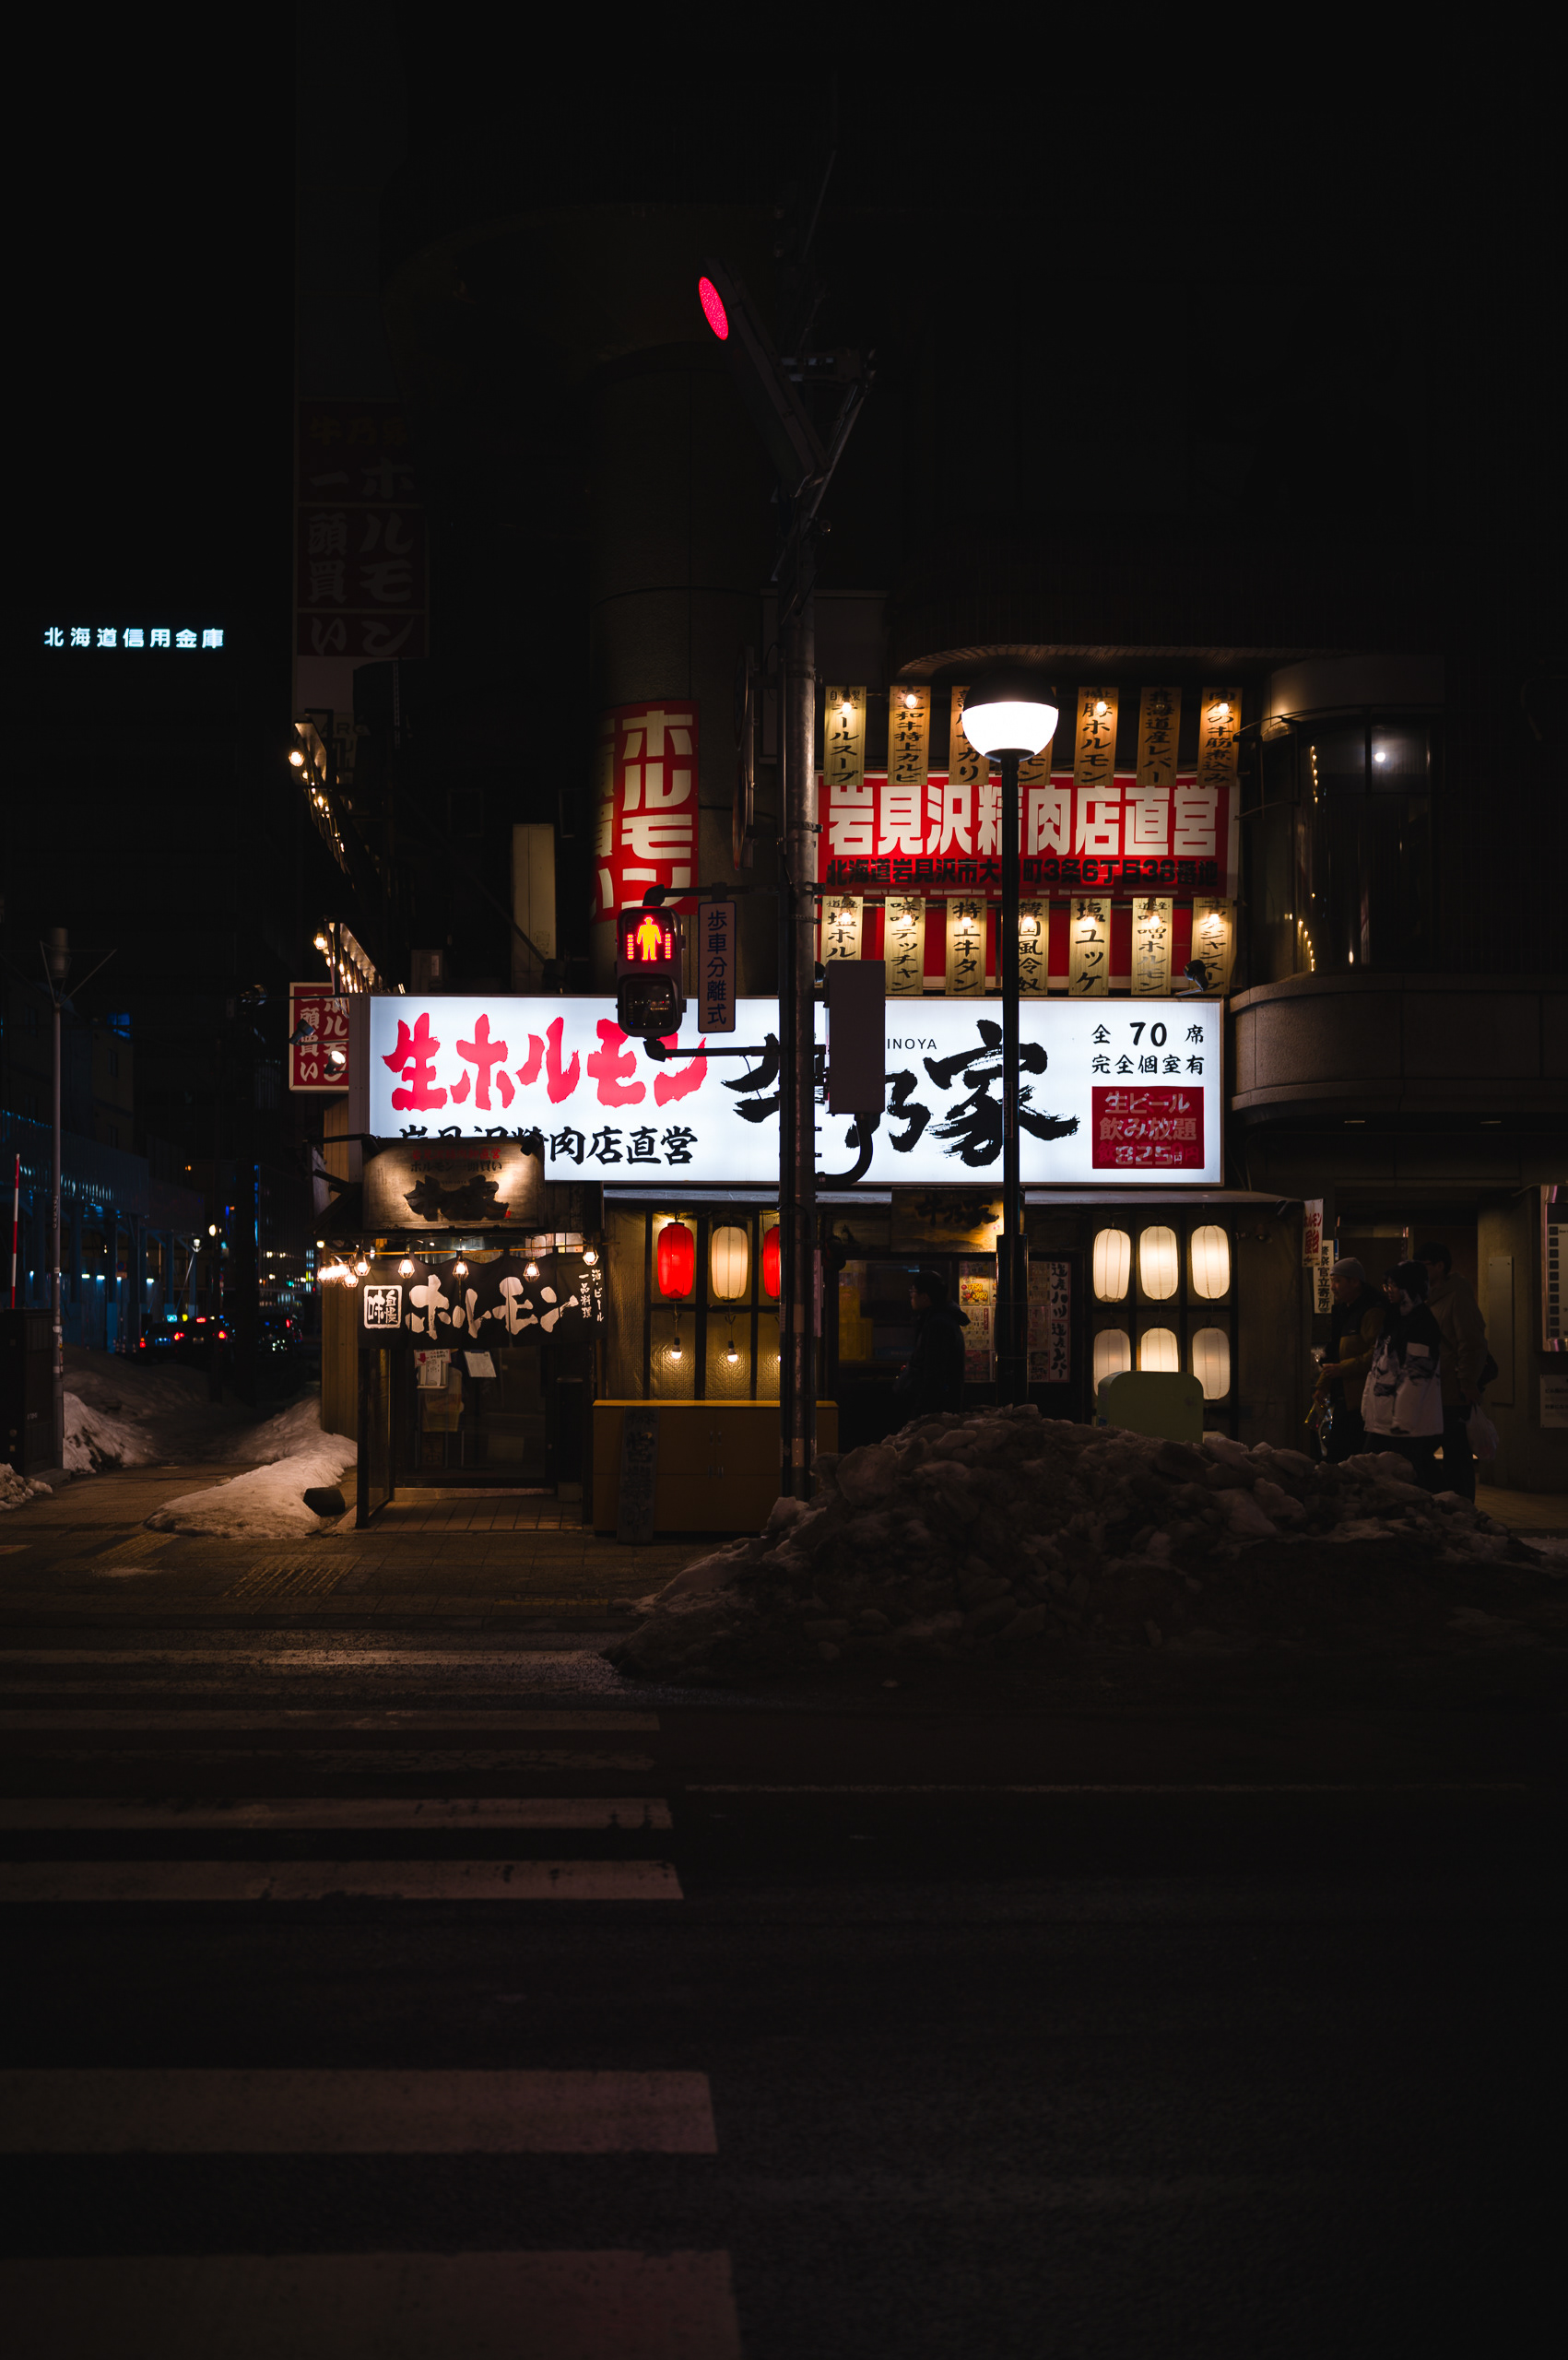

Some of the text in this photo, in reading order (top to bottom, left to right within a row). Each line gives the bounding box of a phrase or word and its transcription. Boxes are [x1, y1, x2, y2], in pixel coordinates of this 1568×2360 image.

[309, 470, 348, 656] 一頭買い
[360, 456, 414, 656] ホルモン
[44, 627, 224, 648] 北海道信用金庫
[828, 785, 1219, 856] 岩見沢精肉店直営
[826, 858, 1219, 887] 北海道岩見沢市大町3条6丁目38番地
[707, 910, 728, 1026] 歩車分離式
[1075, 902, 1105, 992] 塩ユッケ
[887, 1038, 937, 1050] INOYA
[1091, 1021, 1204, 1047] 全 70 席
[382, 1012, 708, 1111] 生ホルモン
[1091, 1054, 1205, 1076] 完全個室有
[1105, 1091, 1191, 1115] 生ビール
[1100, 1117, 1197, 1141] 飲み放題
[405, 1274, 580, 1340] ホルモン
